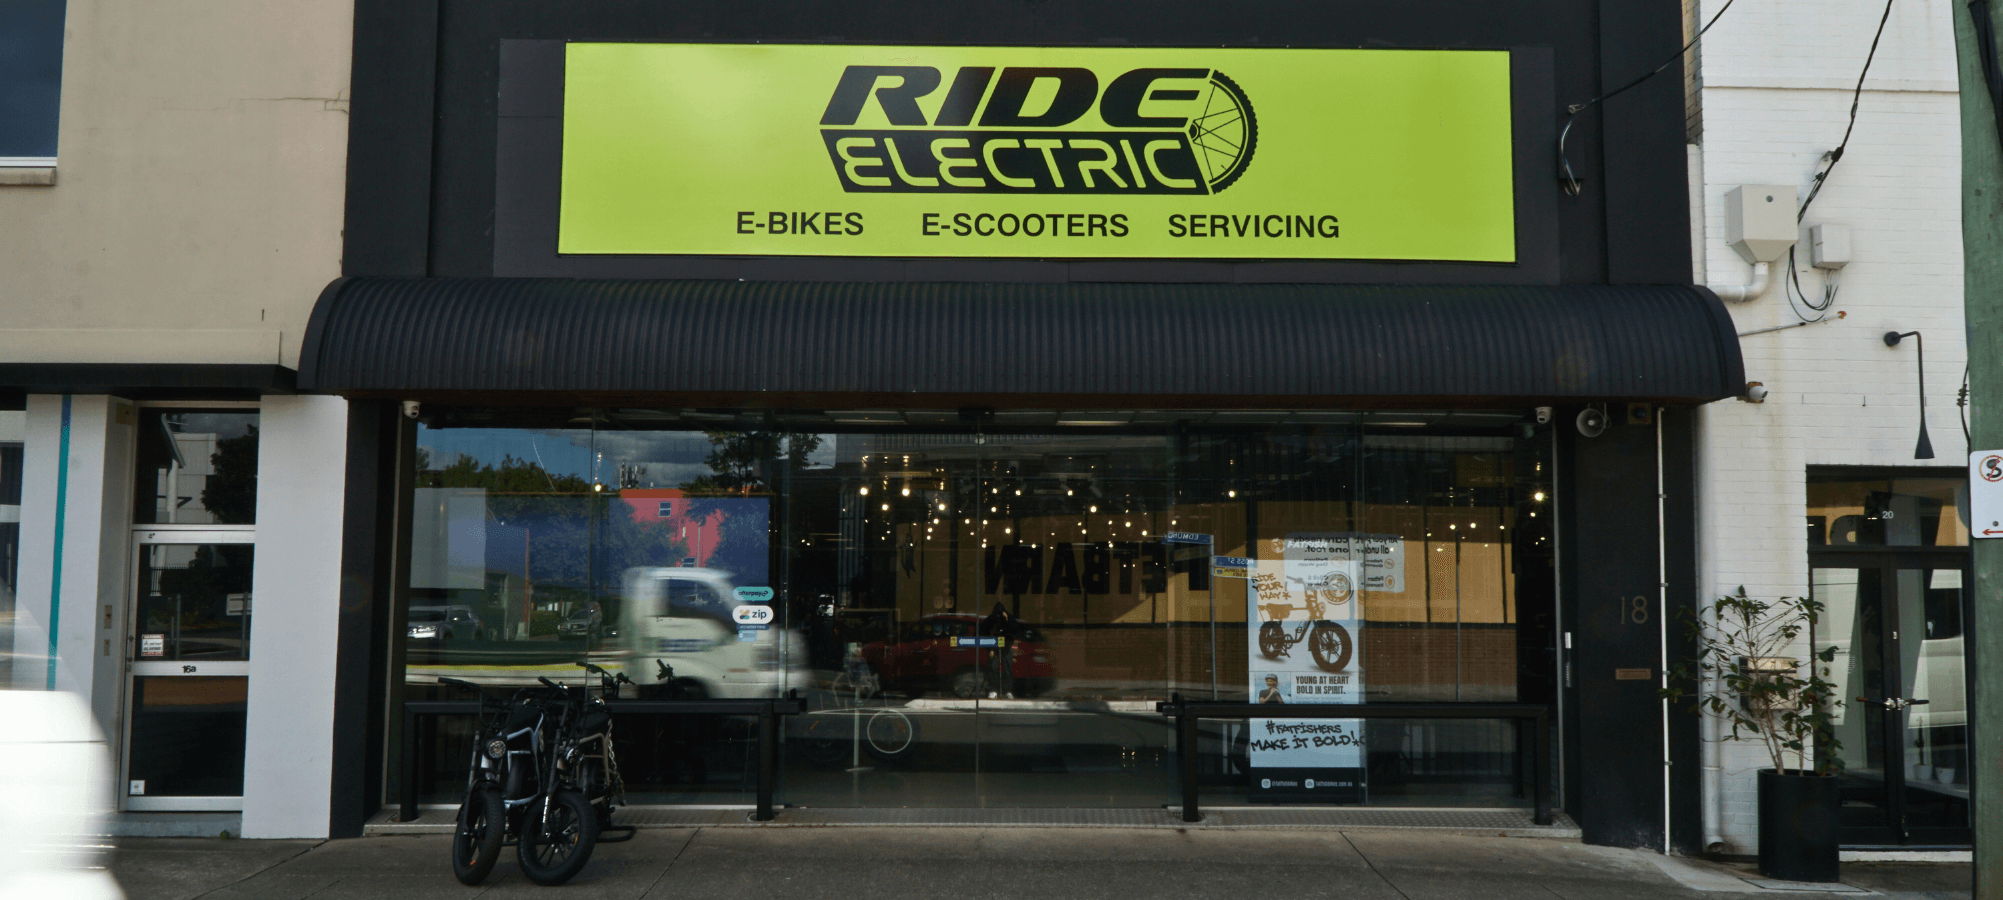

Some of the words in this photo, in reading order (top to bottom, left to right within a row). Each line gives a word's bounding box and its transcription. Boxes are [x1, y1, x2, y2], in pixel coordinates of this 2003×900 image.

[820, 65, 1210, 127] RIDE
[840, 137, 1199, 190] ELECTRIC
[736, 211, 865, 237] E-BIKES
[921, 212, 1130, 238] E-SCOOTERS
[1168, 213, 1341, 239] SERVICING
[1881, 509, 1895, 520] 20
[1251, 572, 1276, 584] RIDE
[1252, 581, 1283, 593] YOUR
[1259, 591, 1281, 601] WAY
[752, 609, 767, 620] zip
[1620, 596, 1649, 625] 18
[182, 665, 197, 674] 16a
[1296, 676, 1317, 685] YOUNG
[1319, 676, 1327, 685] AT
[1329, 676, 1349, 685] HEART
[1296, 685, 1313, 694] BOLD
[1315, 685, 1322, 694] IN
[1323, 685, 1346, 694] SPIRIT.
[1265, 720, 1342, 735] #FATFISHERS
[1250, 737, 1289, 752] MAKE
[1292, 735, 1308, 749] IT
